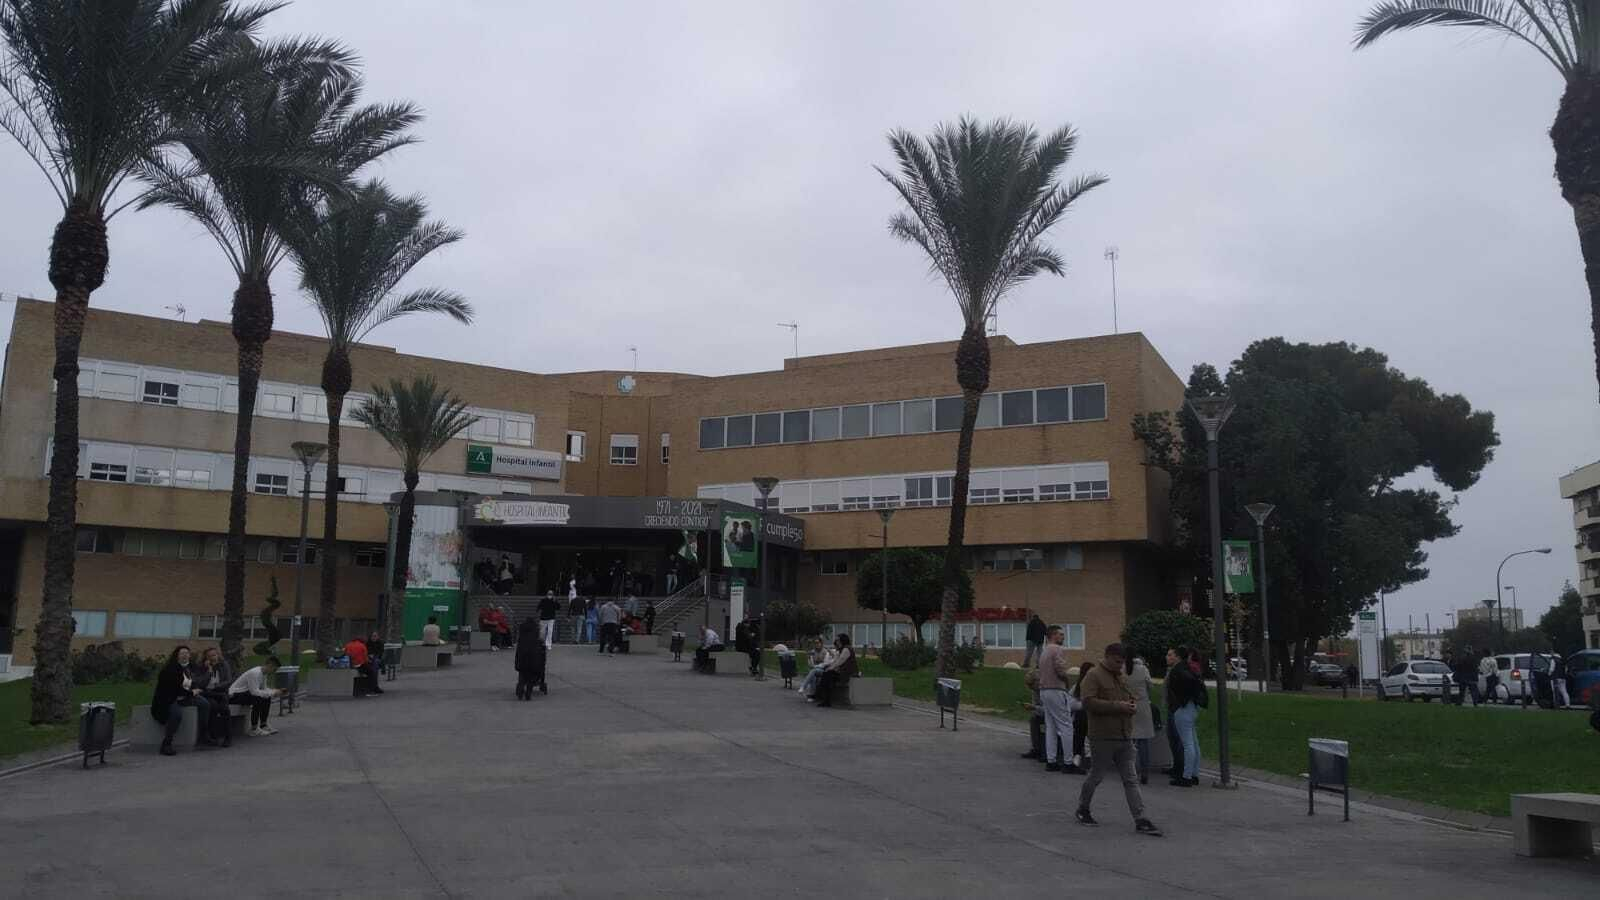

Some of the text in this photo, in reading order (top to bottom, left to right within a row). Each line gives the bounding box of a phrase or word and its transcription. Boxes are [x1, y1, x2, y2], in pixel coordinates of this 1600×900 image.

[496, 455, 556, 468] Hospital Infantil
[504, 503, 536, 517] HOSPITAL
[536, 503, 567, 518] INFANTIL
[656, 500, 671, 514] 1971
[681, 501, 702, 515] 2021
